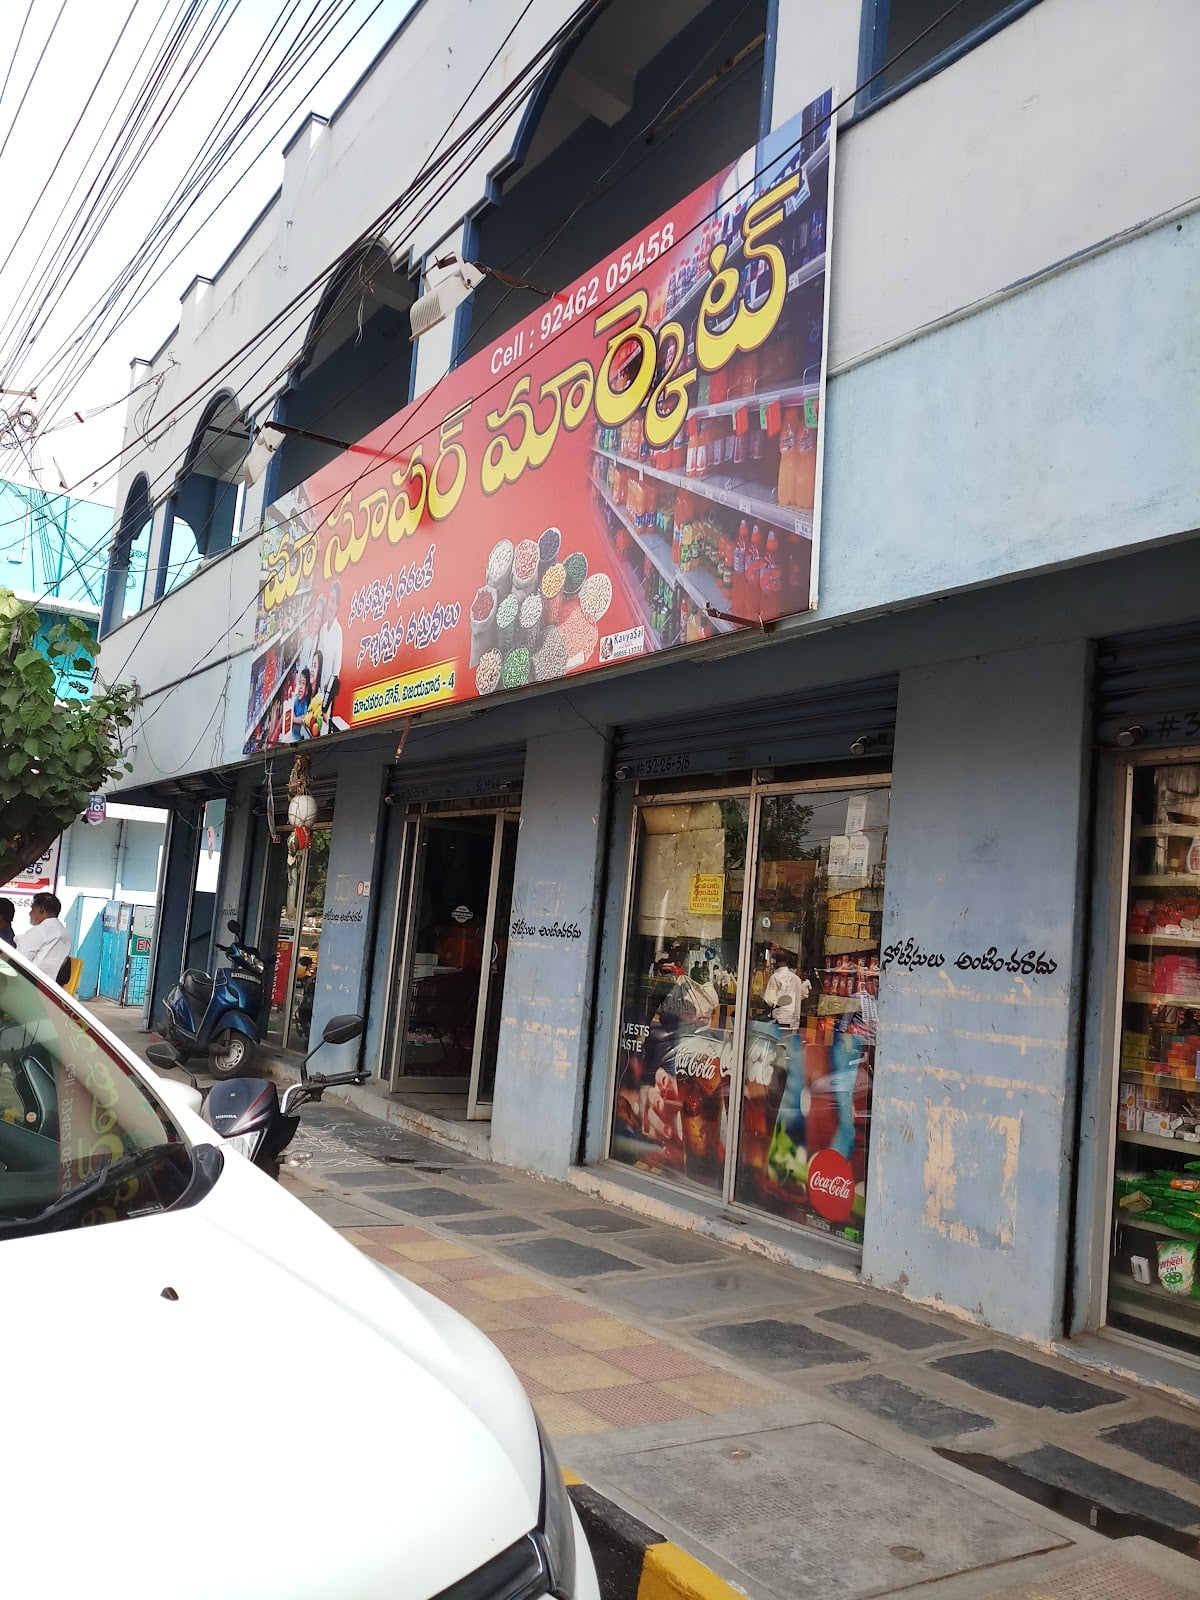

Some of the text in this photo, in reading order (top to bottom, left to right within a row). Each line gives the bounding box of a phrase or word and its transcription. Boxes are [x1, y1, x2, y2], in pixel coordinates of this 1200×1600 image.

[490, 222, 675, 375] Cell : 92462 05458
[263, 172, 801, 613] మా సూపర్ మార్కెట్
[447, 670, 456, 691] 4
[809, 1170, 853, 1199] Coca-Cola
[1159, 1255, 1184, 1270] Wheel
